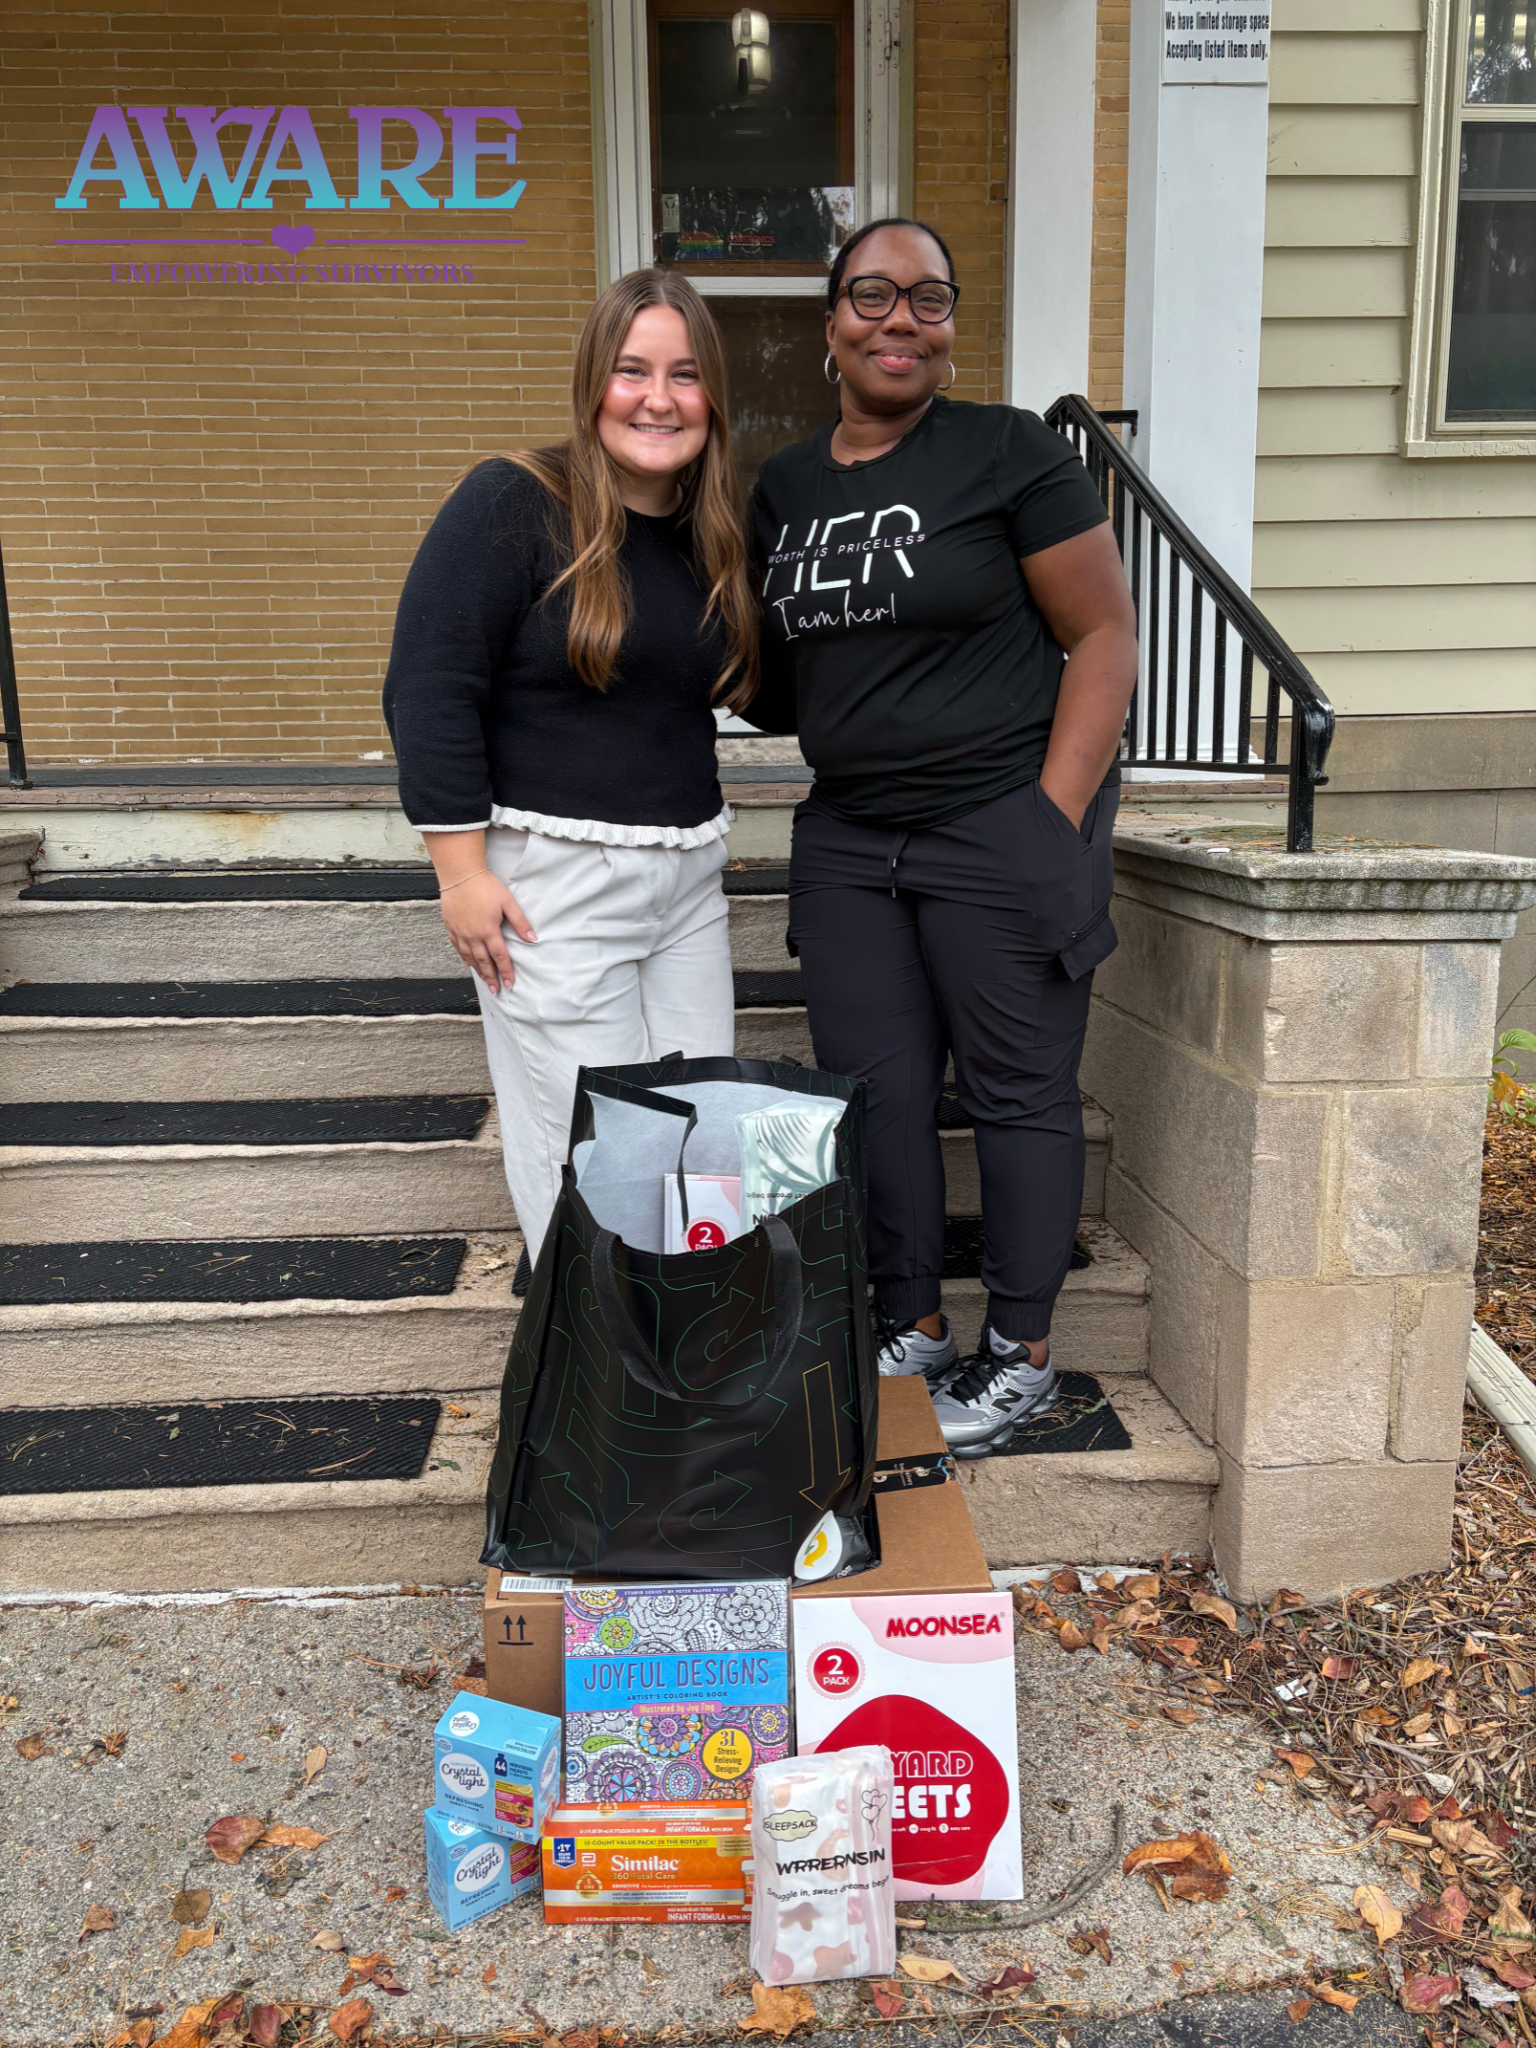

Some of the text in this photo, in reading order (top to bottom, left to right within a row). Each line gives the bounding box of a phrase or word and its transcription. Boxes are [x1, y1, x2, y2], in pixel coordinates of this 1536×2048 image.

[1165, 11, 1269, 33] We have limited storage space
[1166, 40, 1268, 61] Accepting listed items only.
[767, 533, 925, 564] WORTH IS PRICELESS
[699, 1227, 713, 1243] 2
[886, 1612, 1001, 1638] MOONSEA
[827, 1655, 843, 1675] 2
[583, 1657, 770, 1691] JOYFUL DESIGNS
[823, 1676, 850, 1686] PACK
[626, 1690, 728, 1701] ARTIST'S COLORING BOOK
[639, 1703, 675, 1714] Illustrated
[677, 1703, 685, 1714] by
[701, 1702, 715, 1713] Ting
[720, 1731, 737, 1746] 31
[717, 1747, 739, 1755] Stress-
[495, 1760, 507, 1772] 44
[714, 1756, 742, 1766] Relieving
[890, 1750, 974, 1778] YARD
[441, 1763, 482, 1779] Crystal
[716, 1765, 740, 1774] Designs
[458, 1776, 486, 1790] light
[444, 1792, 485, 1809] REFRESHING
[891, 1783, 972, 1819] EETS
[685, 1825, 710, 1833] FORMULA
[764, 1819, 817, 1831] SLEEPSACK
[456, 1846, 498, 1882] Crystal
[474, 1855, 502, 1880] light
[611, 1854, 679, 1871] Similac
[775, 1848, 885, 1876] WRRERNSIN
[612, 1871, 676, 1880] 360 Total Care
[460, 1881, 501, 1905] REFRESHING
[766, 1887, 798, 1902] Snuggle
[800, 1888, 811, 1897] in,
[812, 1887, 838, 1895] sweet
[840, 1883, 870, 1893] dreams
[667, 1913, 692, 1921] INFANT
[693, 1912, 725, 1921] FORMULA
